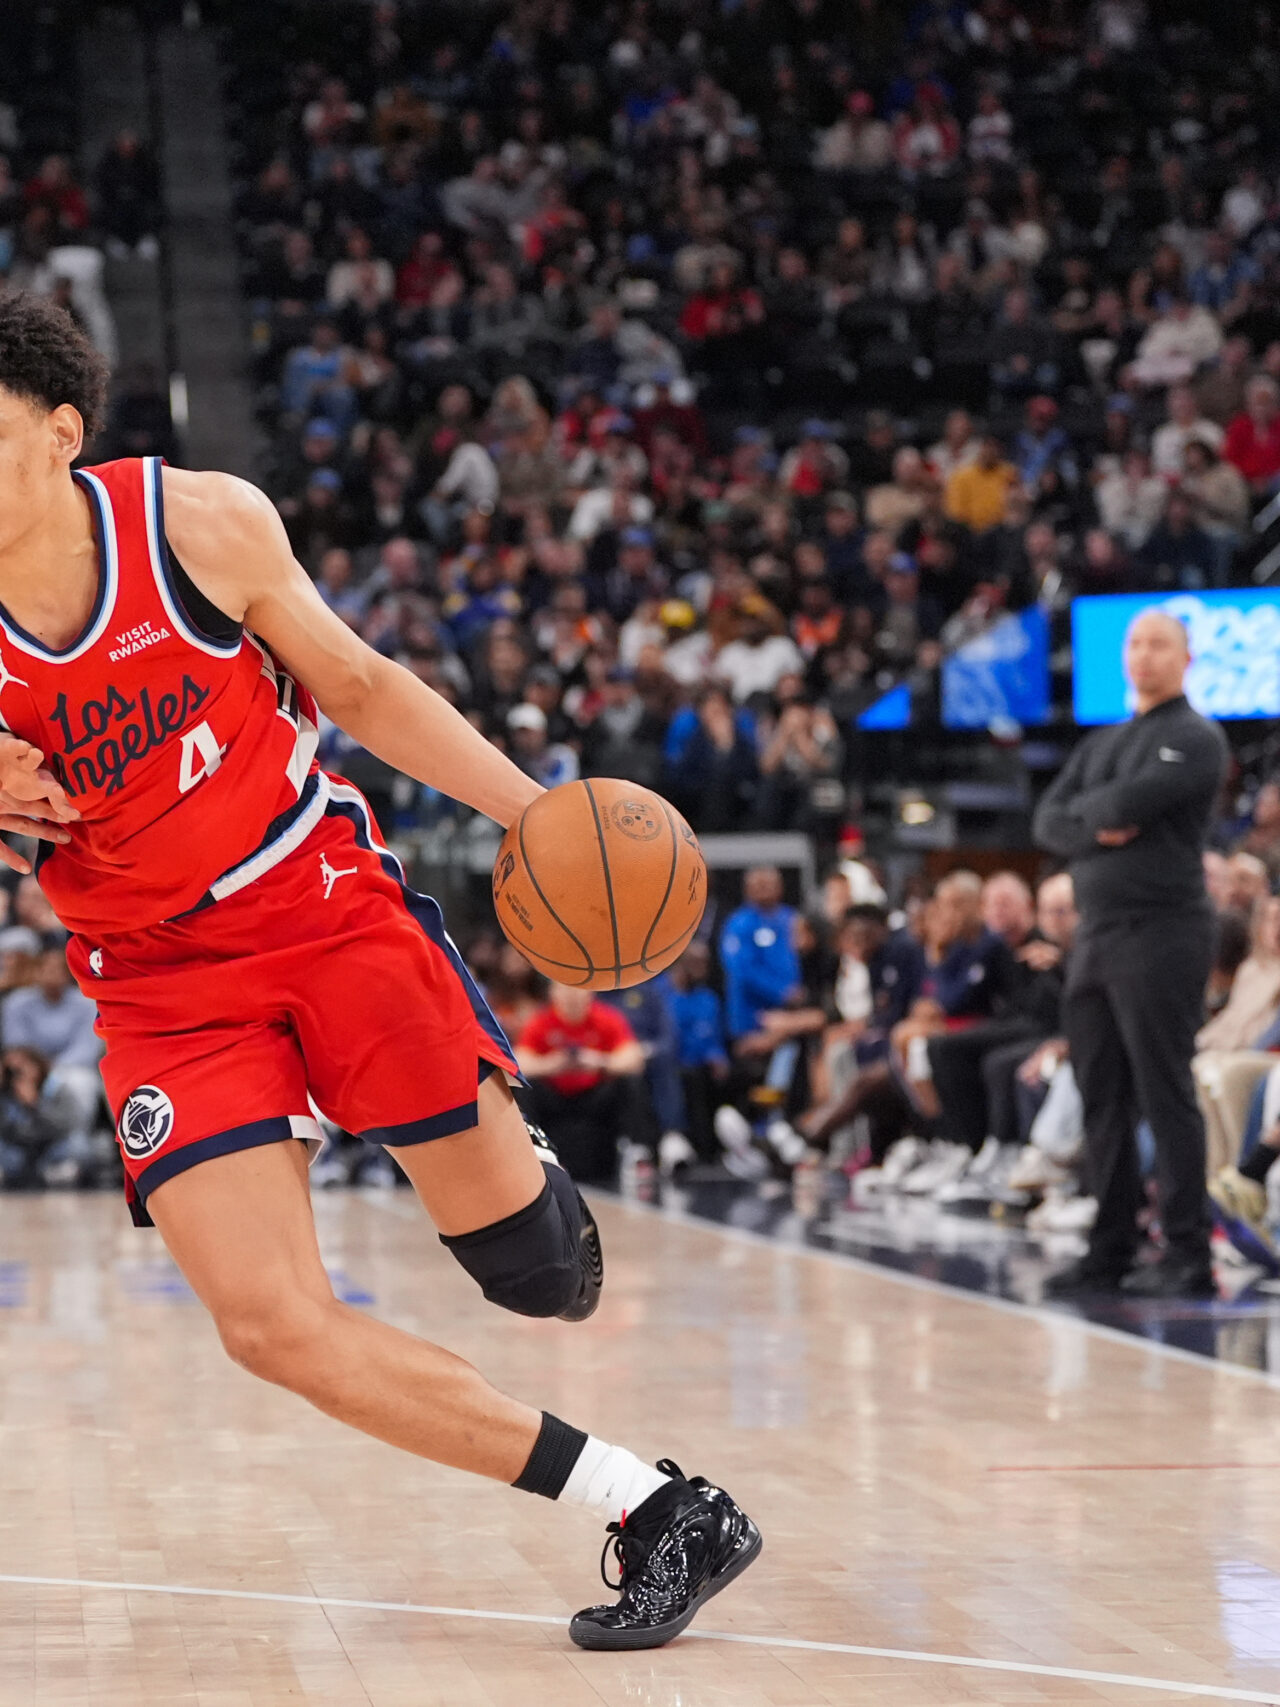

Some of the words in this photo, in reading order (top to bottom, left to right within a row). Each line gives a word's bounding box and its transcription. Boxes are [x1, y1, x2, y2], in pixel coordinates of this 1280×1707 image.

[108, 627, 171, 662] RWANDA
[115, 621, 152, 645] VISIT
[48, 684, 137, 755] Los
[178, 720, 227, 794] 4
